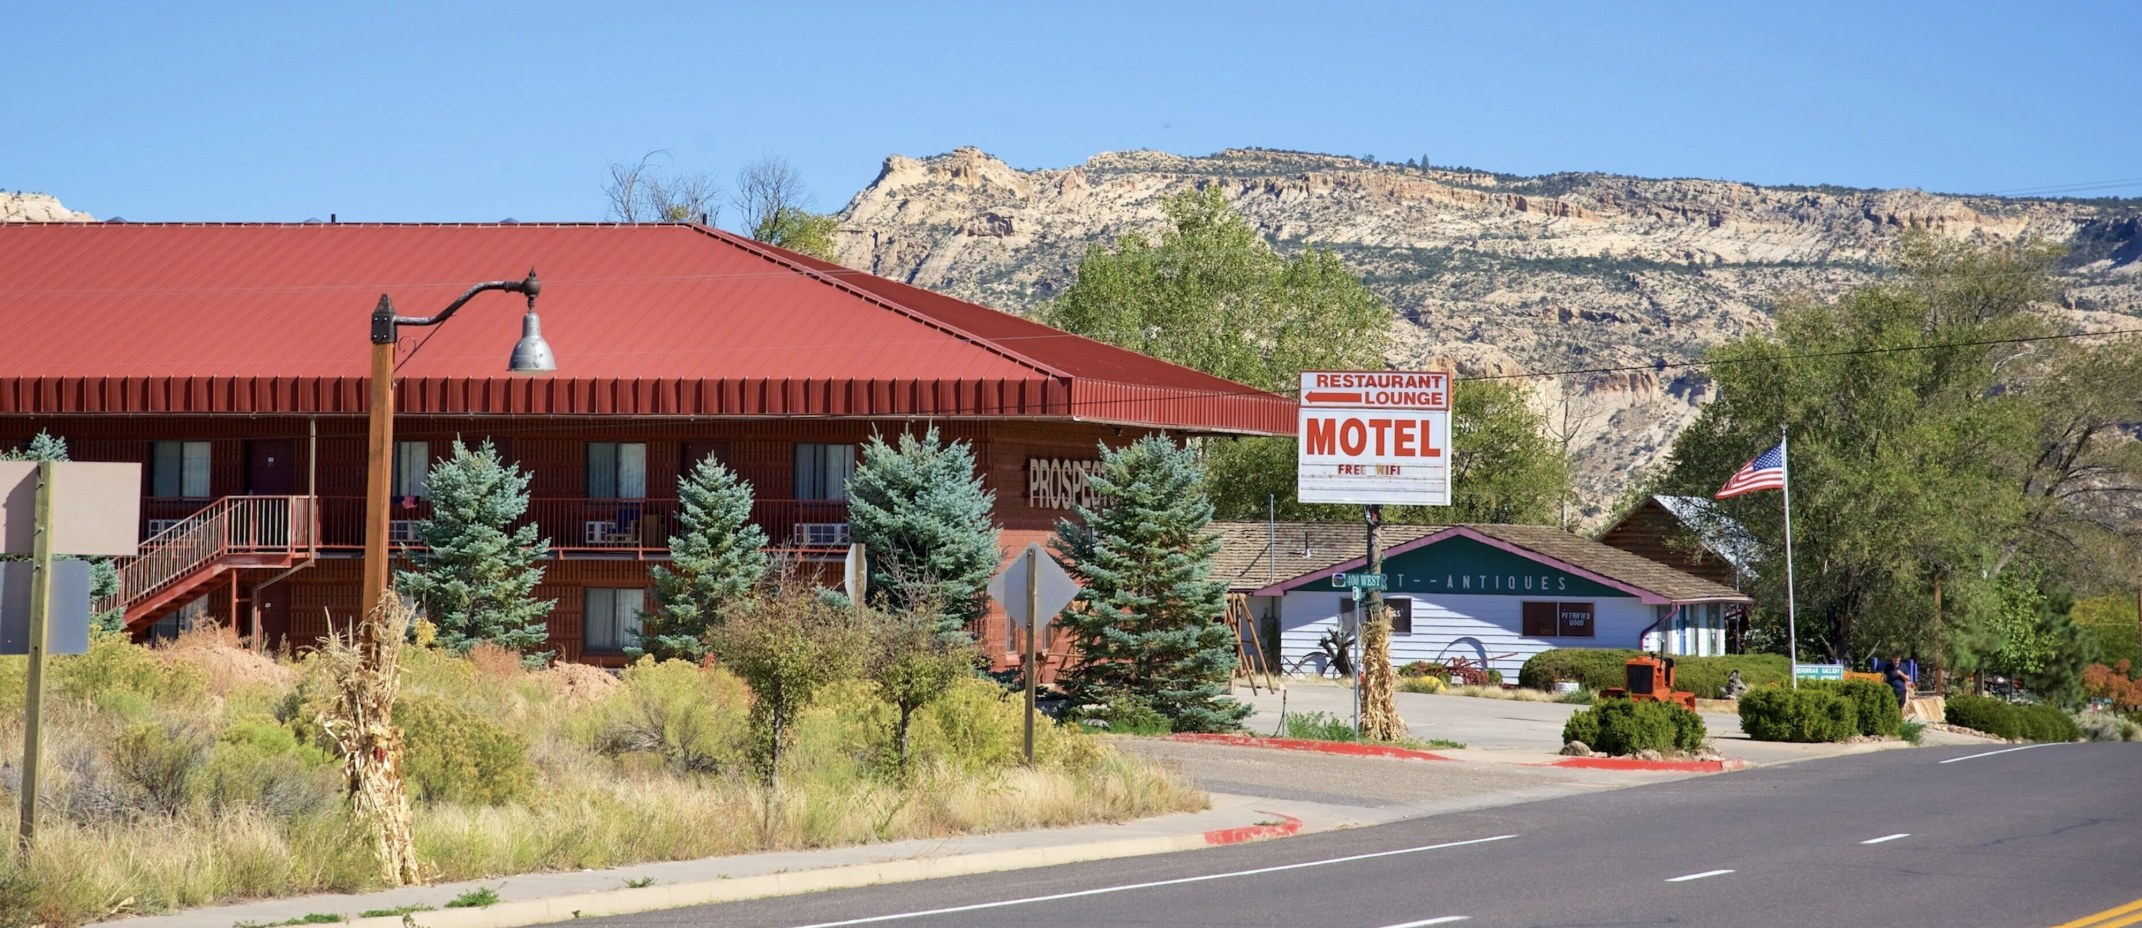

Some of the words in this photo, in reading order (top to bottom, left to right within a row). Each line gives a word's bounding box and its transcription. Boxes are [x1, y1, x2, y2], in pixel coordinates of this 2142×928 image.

[1316, 374, 1443, 389] RESTAURANT
[1365, 391, 1443, 405] LOUNGE
[1306, 417, 1441, 458] MOTEL
[1337, 464, 1367, 475] FREE
[1376, 465, 1401, 476] WIFI
[1347, 574, 1360, 587] 400
[1360, 575, 1381, 587] WEST
[1446, 574, 1566, 591] ANTIQUES
[1561, 612, 1591, 620] PETRIFIED
